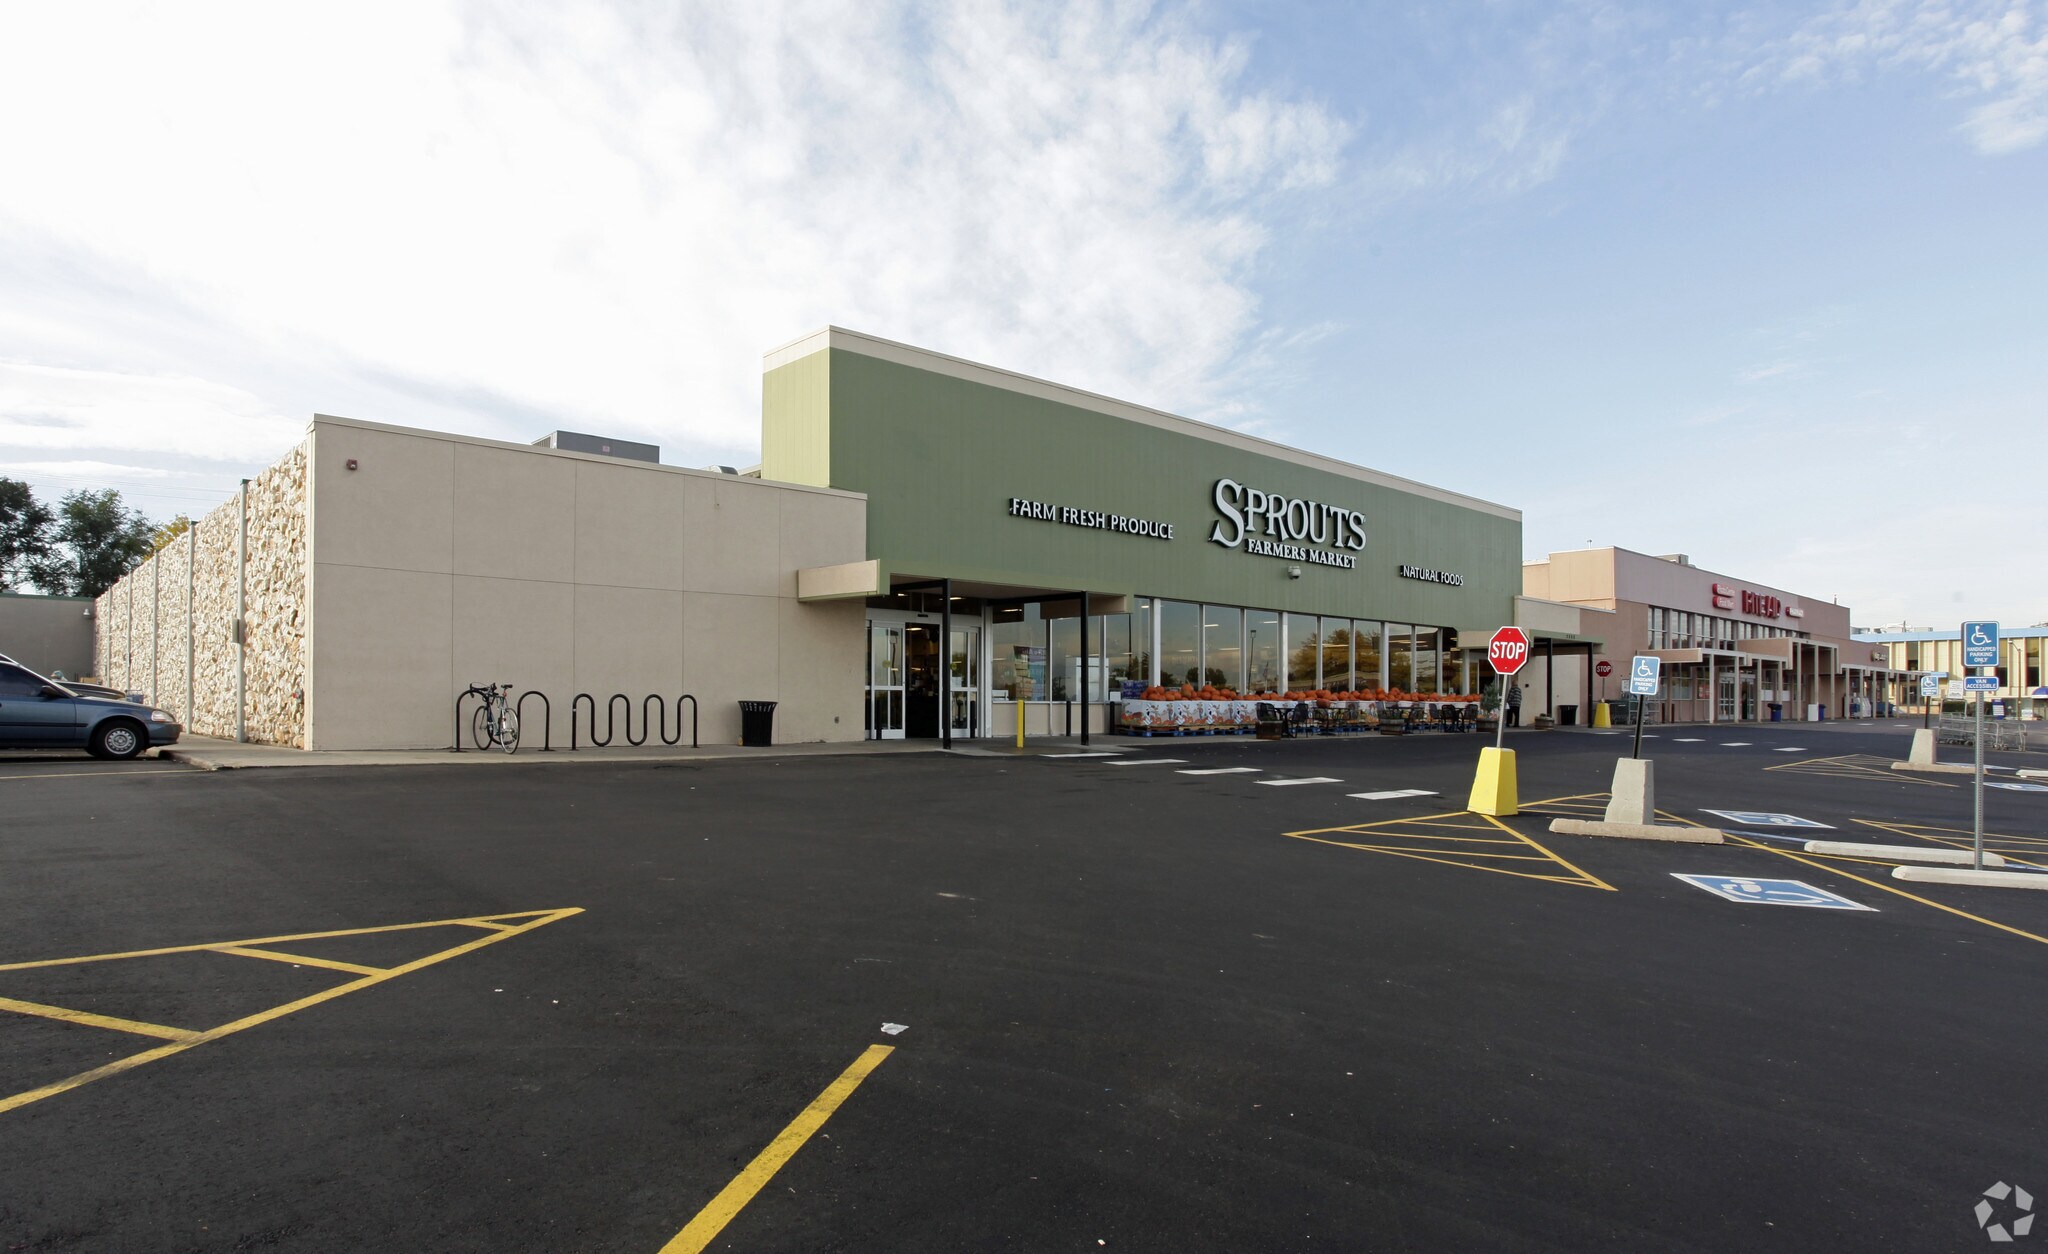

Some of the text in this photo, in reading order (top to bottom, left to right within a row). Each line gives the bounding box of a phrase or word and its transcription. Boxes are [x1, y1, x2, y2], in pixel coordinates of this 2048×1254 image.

[1010, 497, 1174, 540] FARM FRESH PRODUCE
[1209, 478, 1367, 551] SPROUTS
[1247, 538, 1357, 569] FARMERS MARKET
[1402, 565, 1464, 586] NATURAL FOODS
[1491, 641, 1525, 660] STOP
[1596, 665, 1611, 673] STOP
